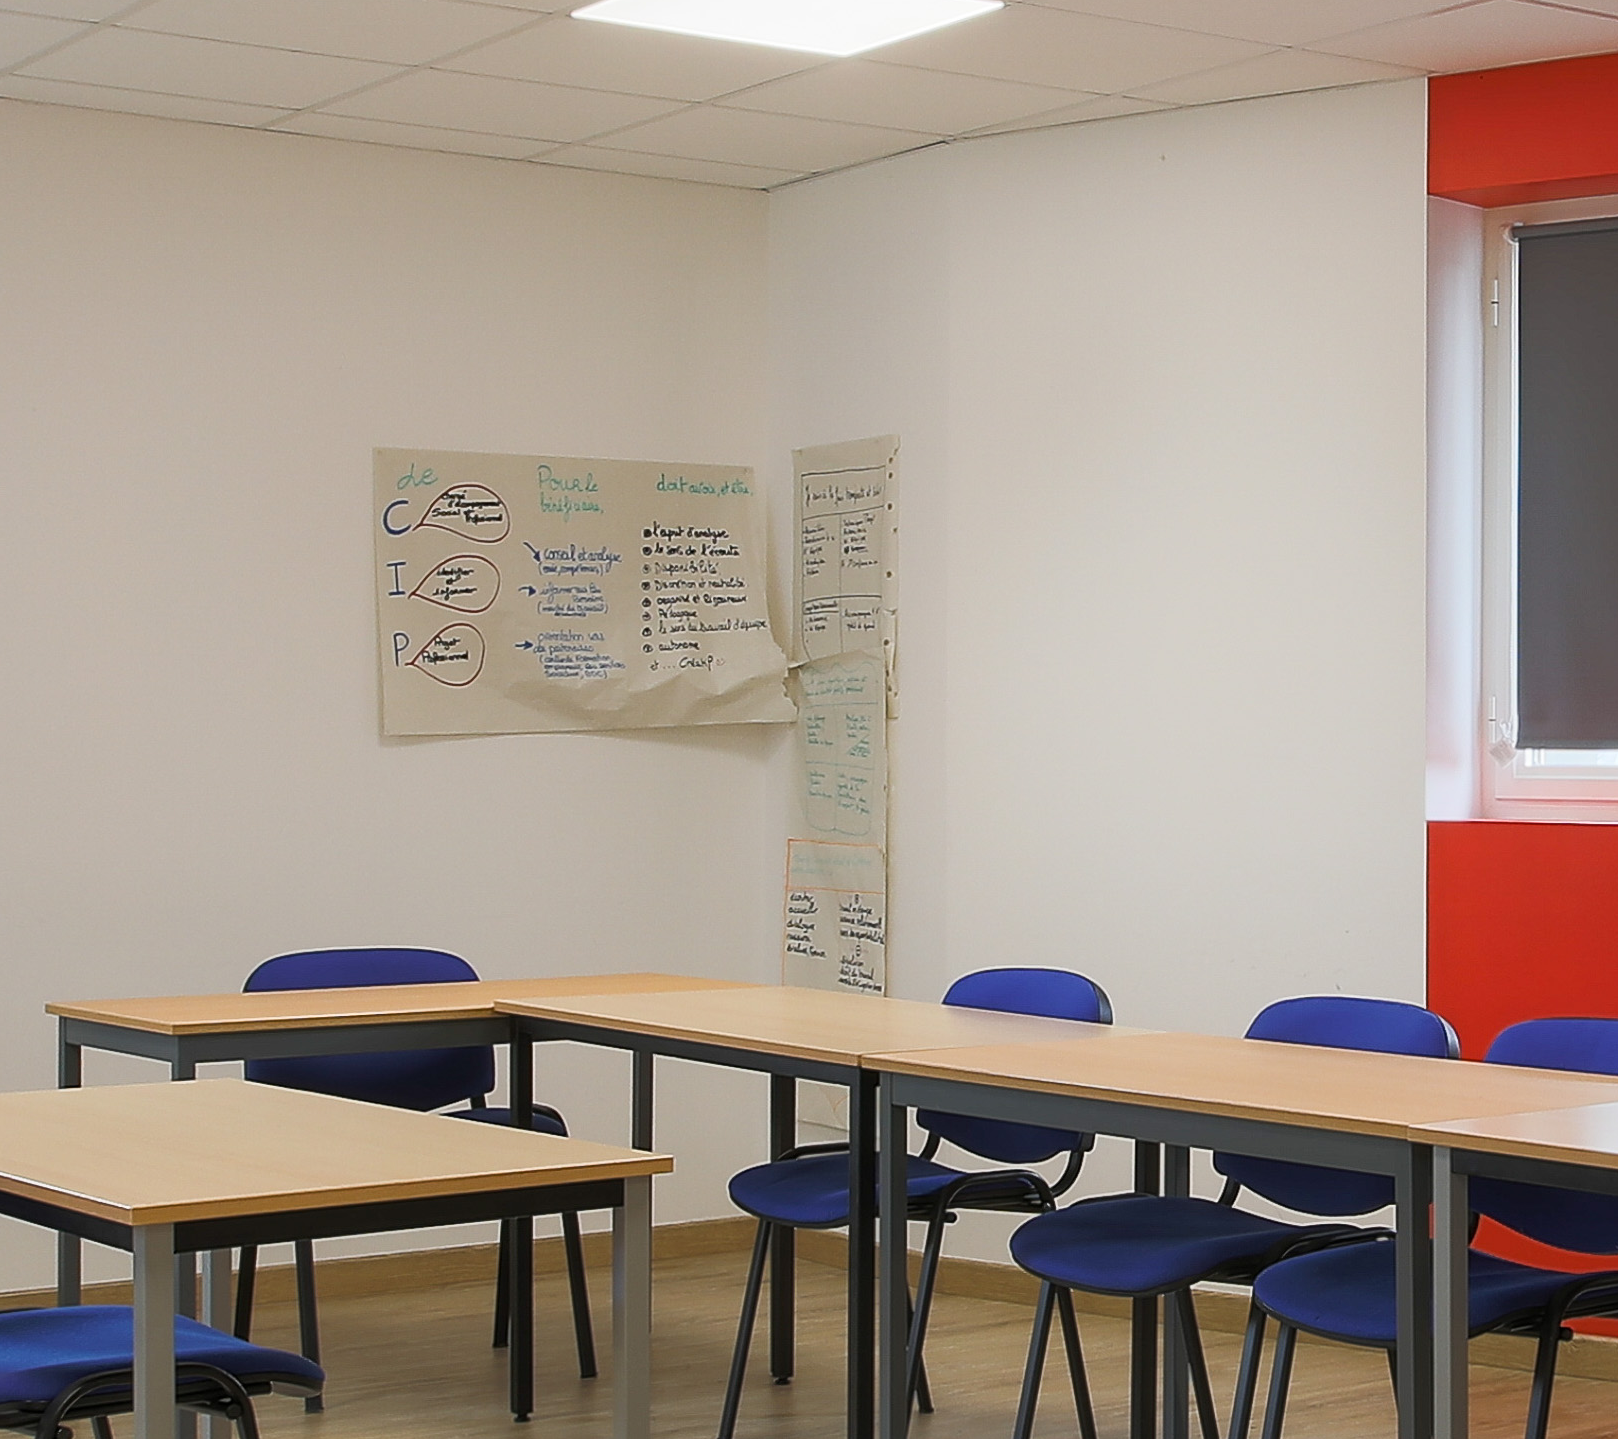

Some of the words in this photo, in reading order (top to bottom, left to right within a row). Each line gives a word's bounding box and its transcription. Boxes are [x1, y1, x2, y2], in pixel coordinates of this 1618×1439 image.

[383, 499, 411, 535] C
[387, 562, 406, 595] I
[394, 632, 409, 666] P
